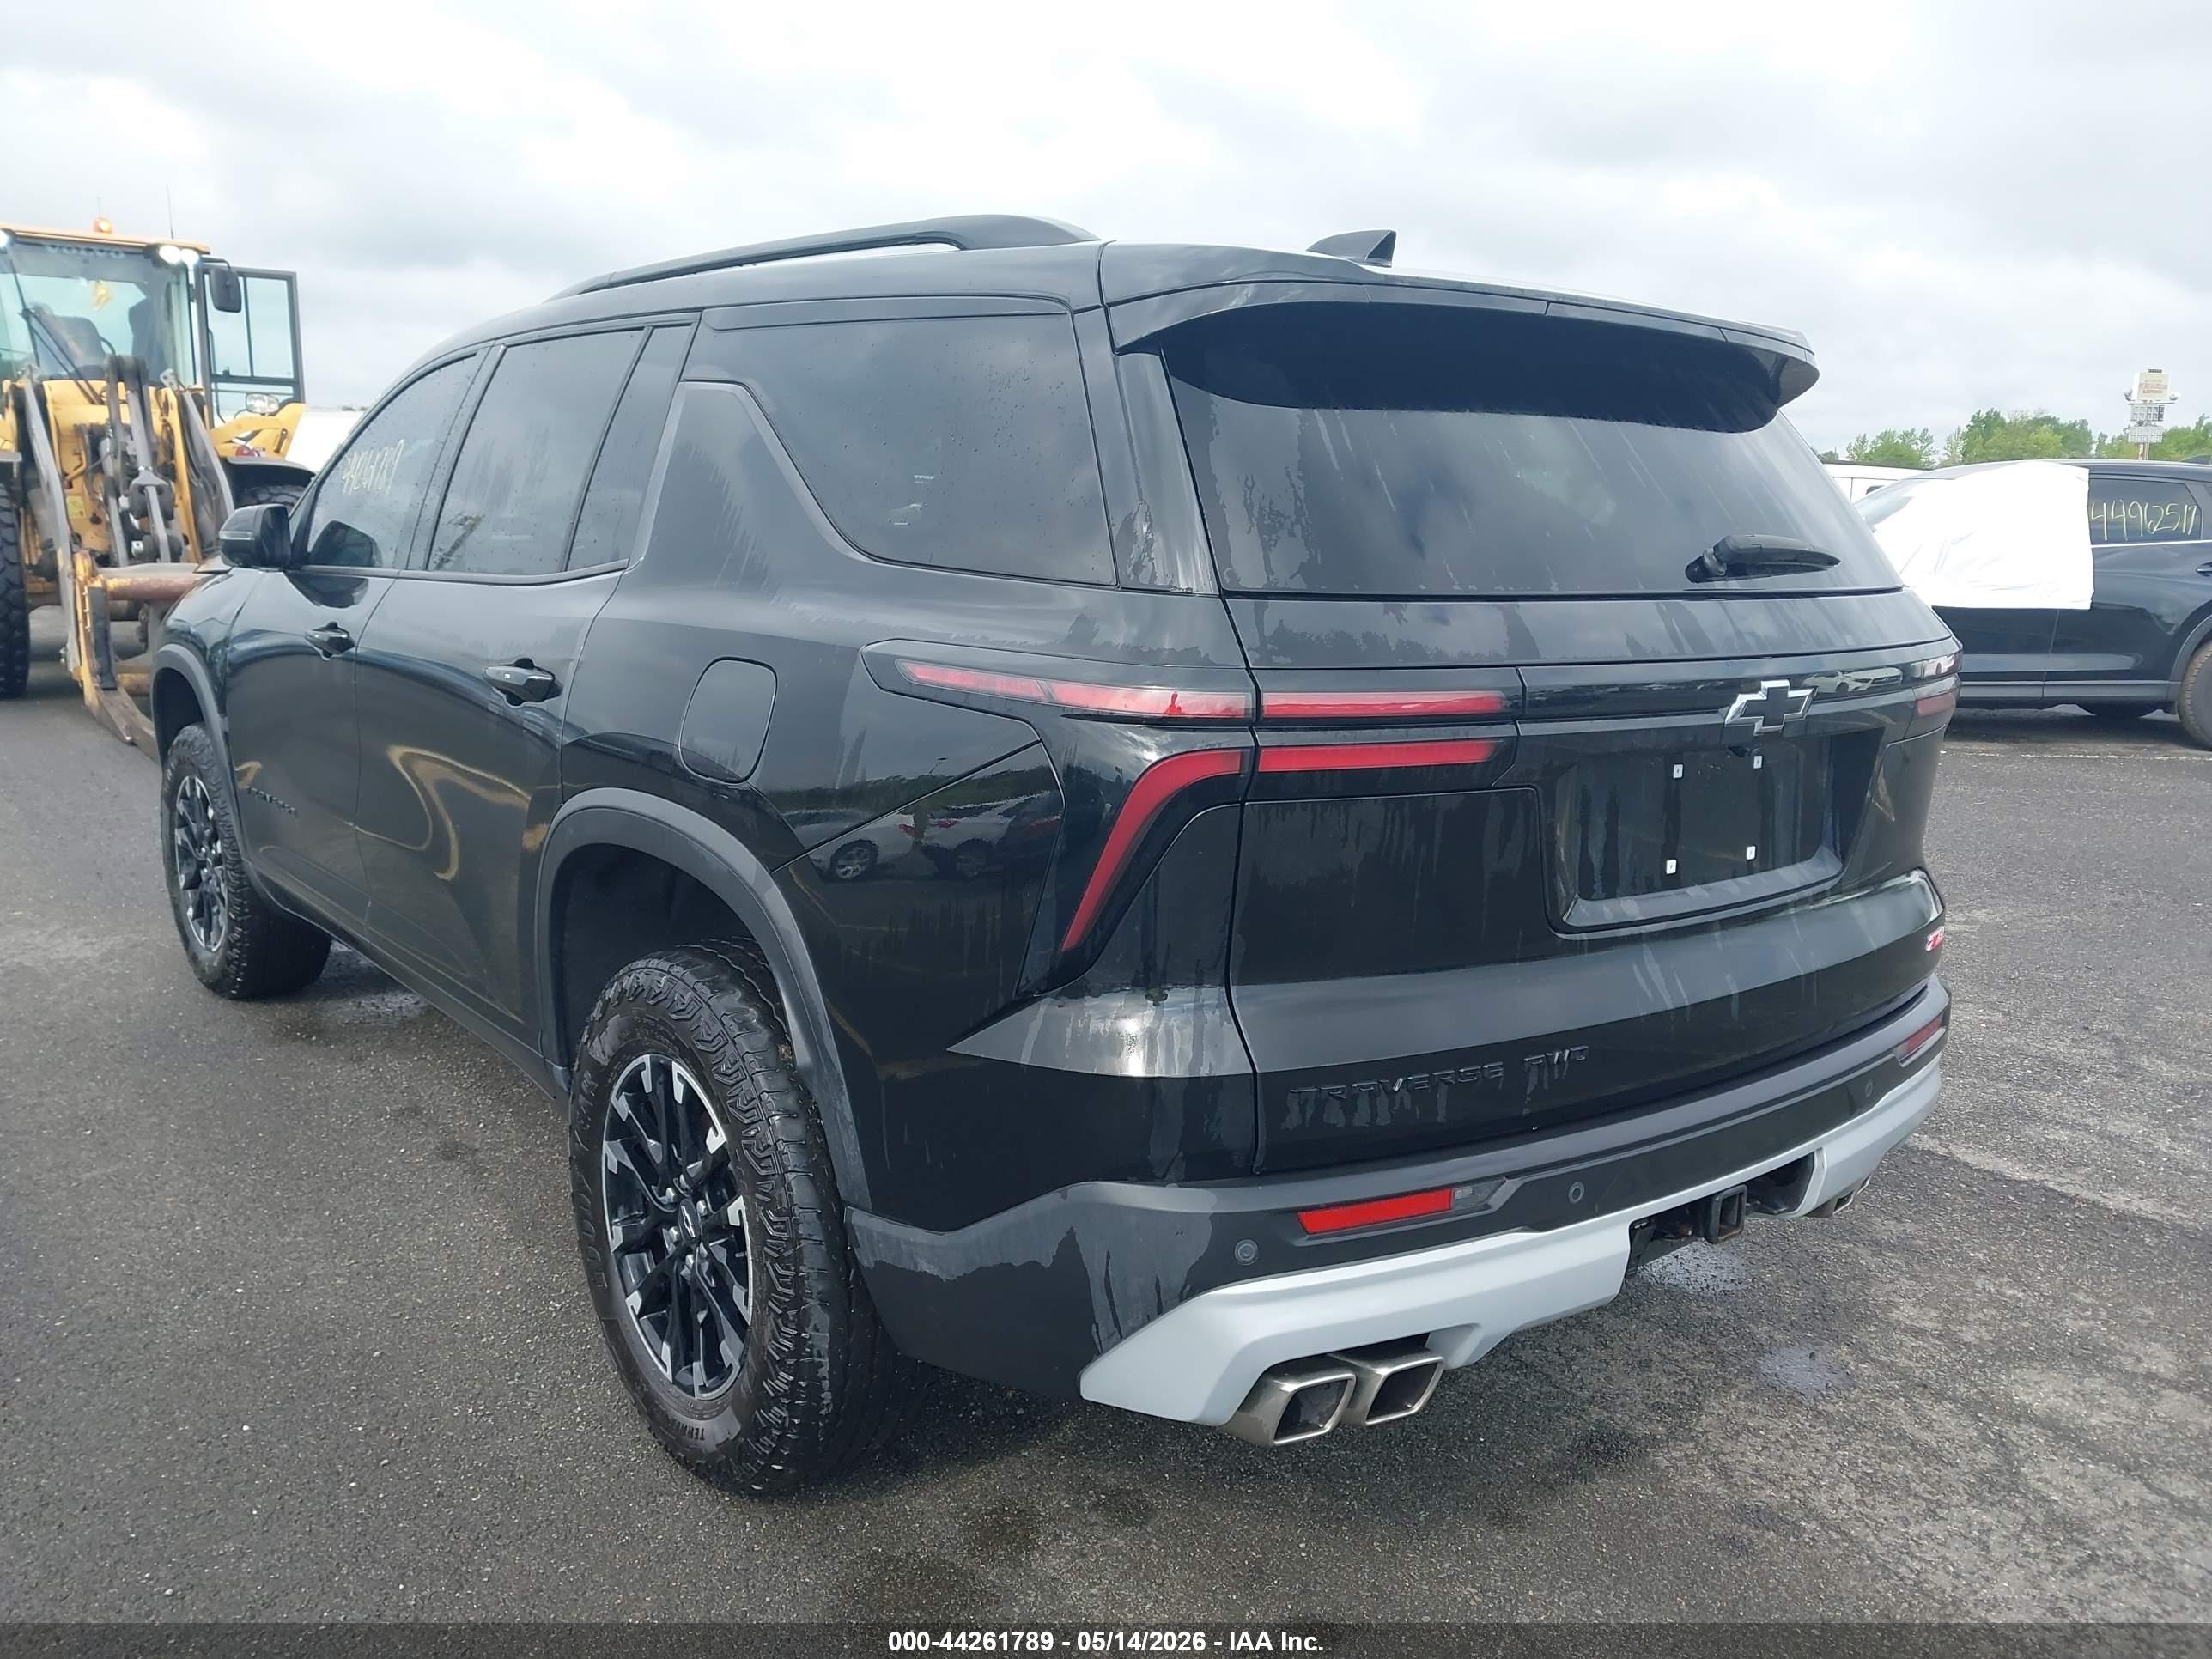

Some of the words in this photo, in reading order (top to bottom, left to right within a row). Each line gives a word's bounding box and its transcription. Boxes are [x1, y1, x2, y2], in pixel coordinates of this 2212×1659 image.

[2091, 499, 2198, 542] 44962517
[1291, 1061, 1504, 1101] TRAVERSE
[1523, 1045, 1589, 1067] AWD
